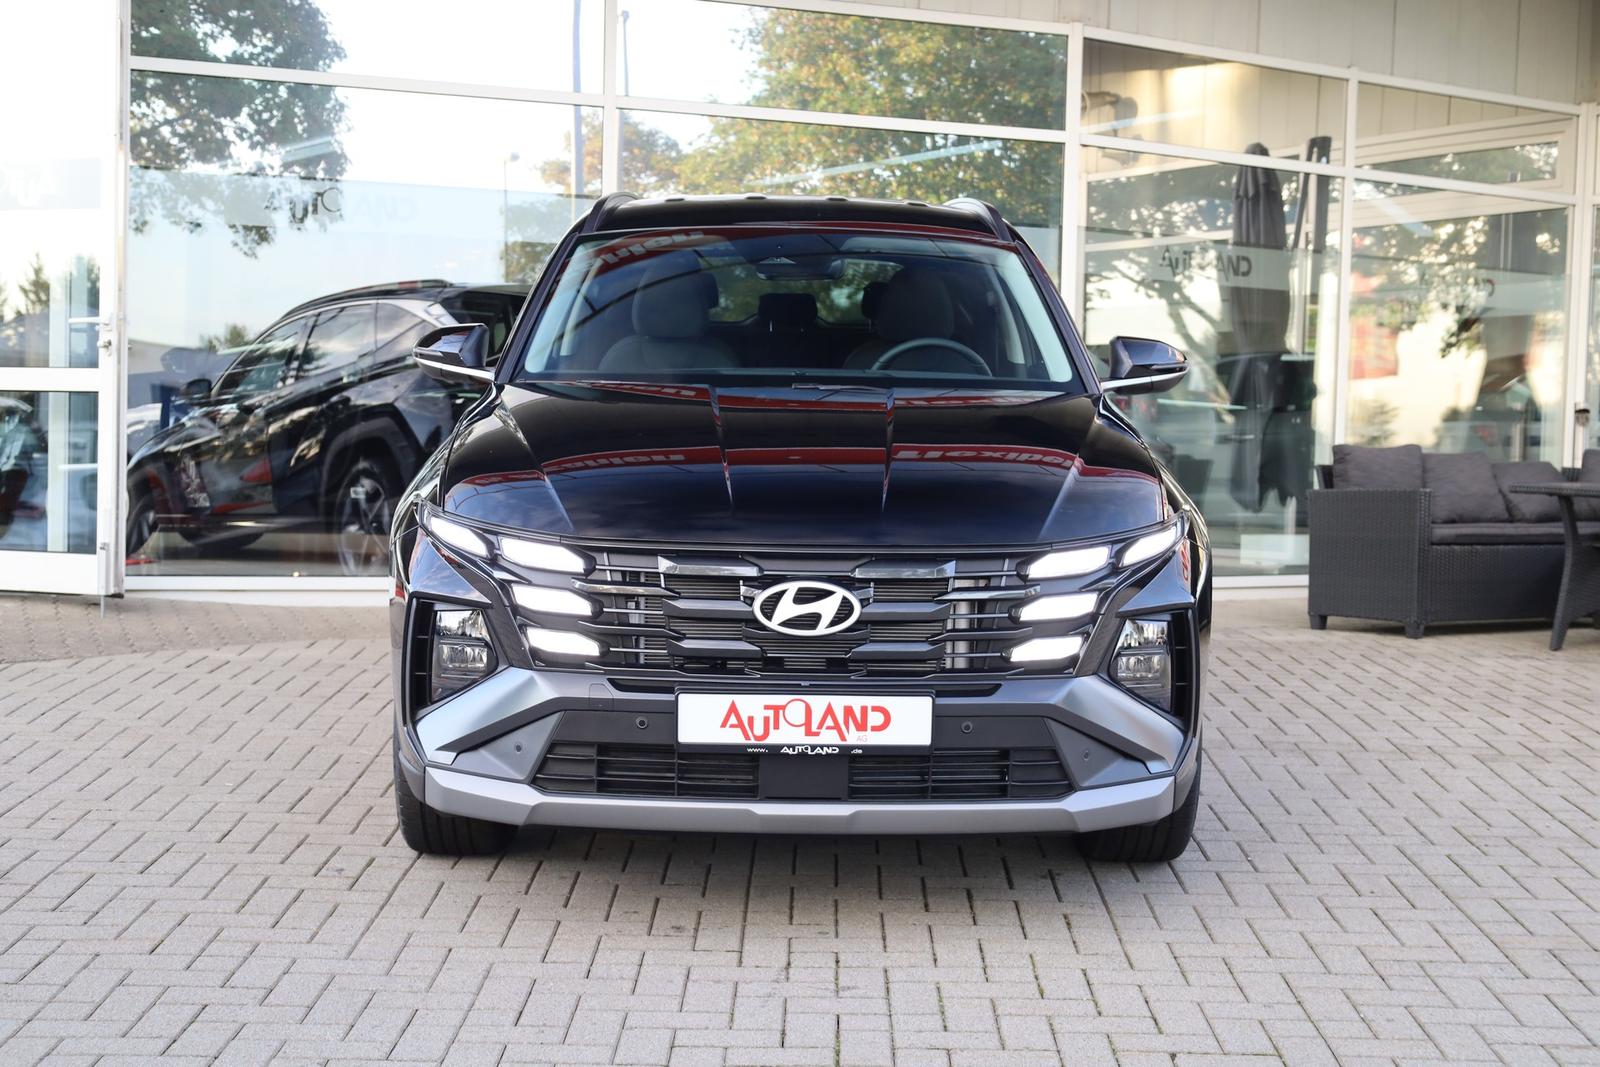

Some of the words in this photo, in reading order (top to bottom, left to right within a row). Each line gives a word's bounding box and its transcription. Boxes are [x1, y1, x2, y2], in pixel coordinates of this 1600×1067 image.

[719, 698, 891, 742] AUTOLAND
[856, 735, 868, 743] AG
[780, 745, 840, 755] AUTOLAND
